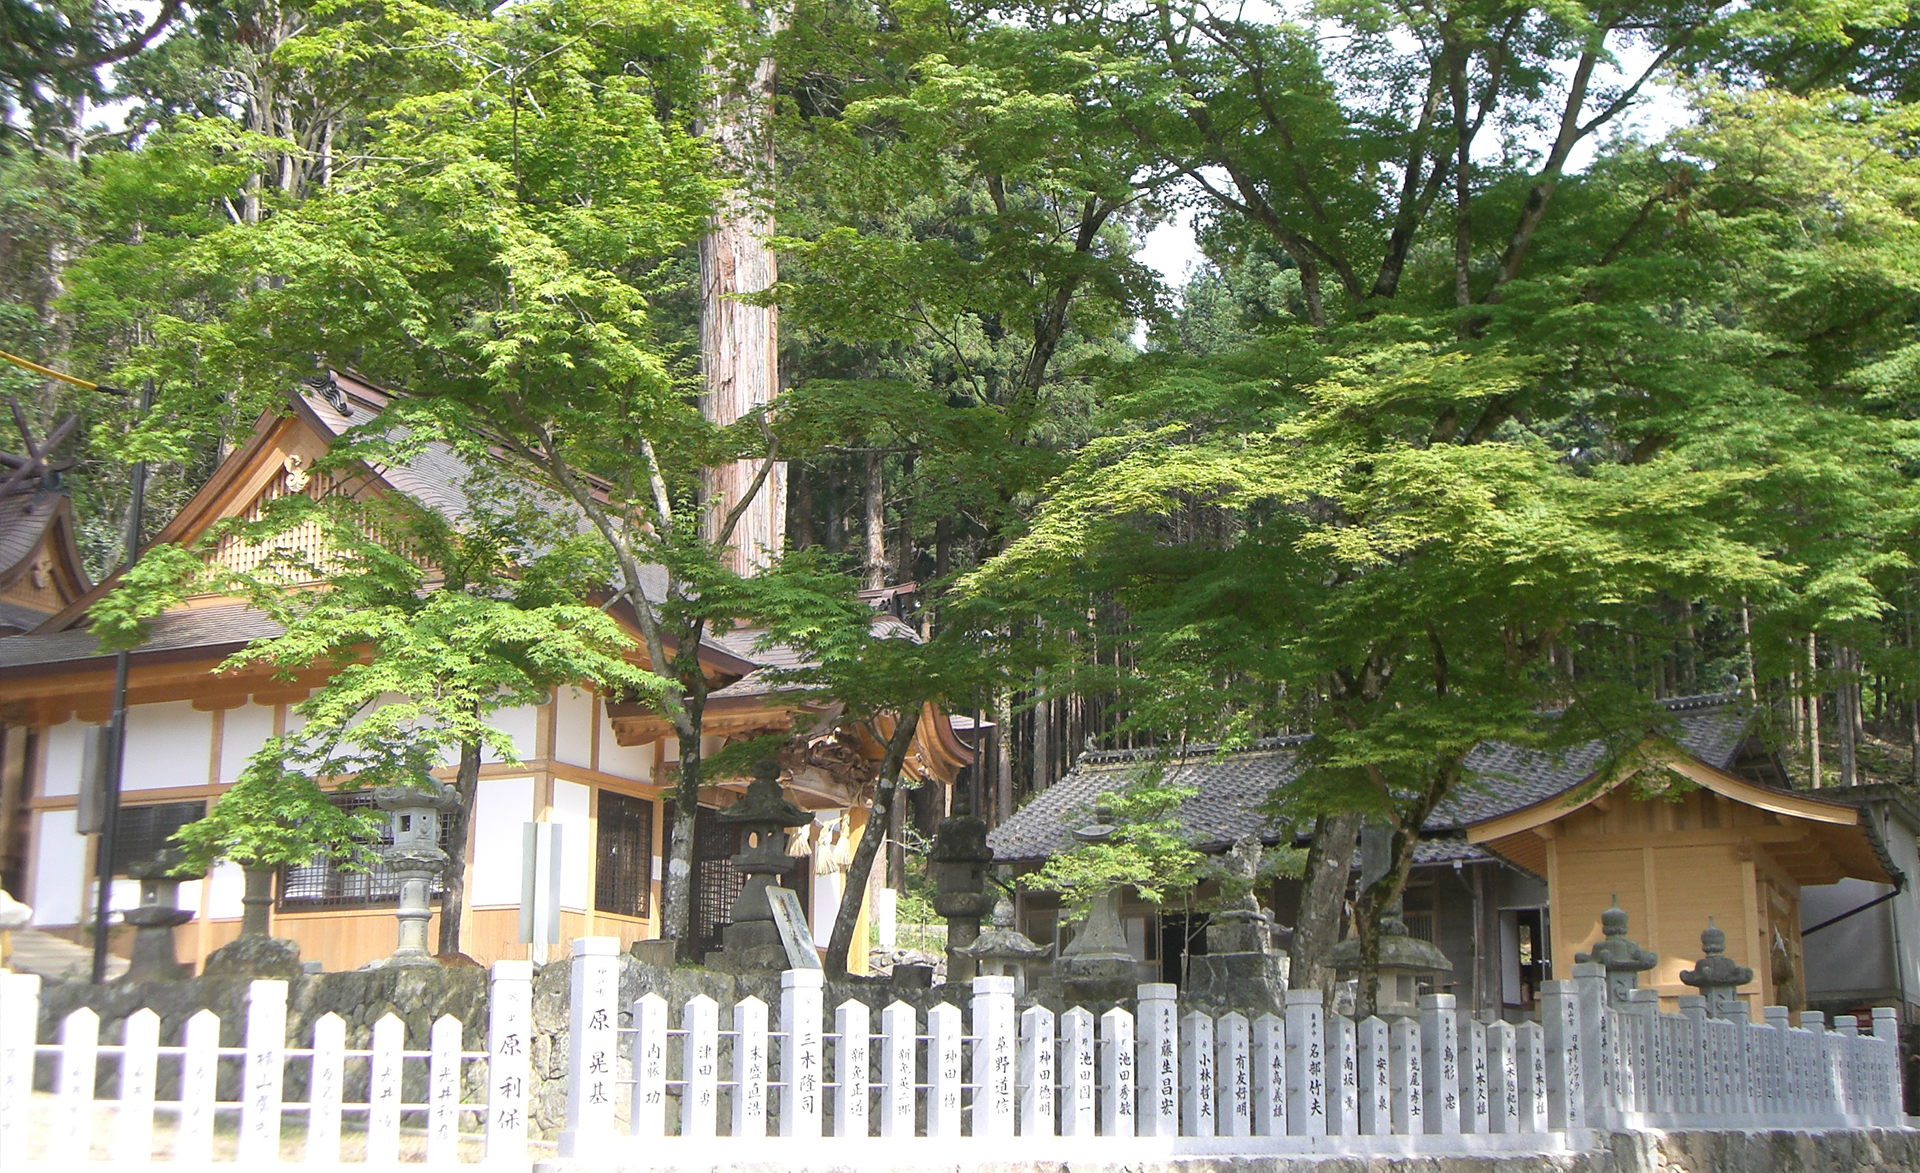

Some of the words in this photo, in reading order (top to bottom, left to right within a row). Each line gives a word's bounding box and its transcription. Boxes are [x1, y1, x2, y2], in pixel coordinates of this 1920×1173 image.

[497, 1033, 522, 1130] 原利保
[588, 1008, 610, 1105] 原晃基
[1199, 1053, 1212, 1117] 小林哲夫
